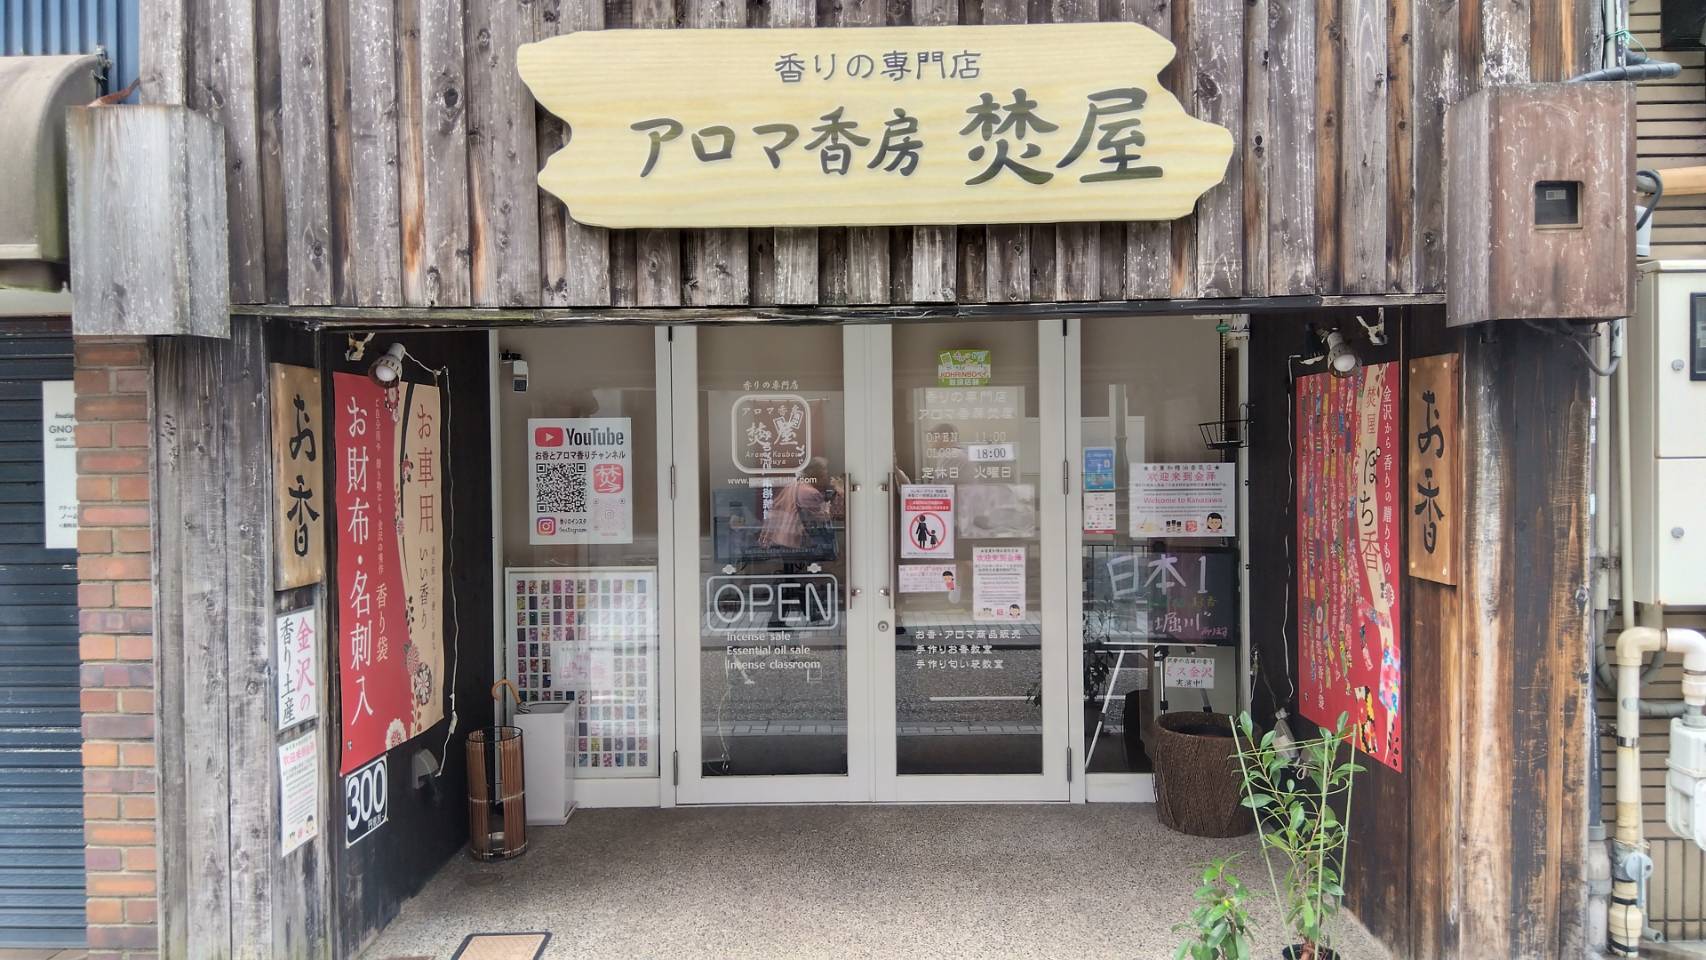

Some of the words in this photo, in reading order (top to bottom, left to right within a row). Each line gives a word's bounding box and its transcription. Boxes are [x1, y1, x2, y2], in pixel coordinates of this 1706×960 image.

[774, 50, 982, 83] 香りの専門店
[630, 106, 925, 178] アロマ香房
[958, 86, 1164, 187] 焚屋
[743, 380, 799, 391] 香りの専門店
[49, 425, 73, 433] GNO
[1383, 385, 1393, 449] 金沢から
[566, 427, 624, 445] YouTube
[926, 432, 958, 442] OPEN
[417, 403, 435, 536] お車用
[535, 450, 626, 460] お香とアロマ香りチャンネル
[745, 450, 770, 458] Arom
[976, 448, 1006, 458] 18:00
[287, 393, 320, 557] お香
[922, 467, 959, 479] 定休日
[974, 466, 1011, 479] 火曜日
[1415, 390, 1446, 554] お香
[1359, 447, 1382, 571] ぽち香
[1382, 455, 1393, 575] 香りの贈りもの
[346, 396, 374, 726] お財布・名刺入
[419, 547, 430, 631] いい香り
[714, 583, 832, 623] OPEN
[376, 582, 388, 663] 香り袋
[727, 631, 765, 641] Incense
[770, 631, 791, 641] sale
[915, 630, 1021, 640] お香・アロマ商品販売
[297, 617, 315, 712] 金沢の
[727, 645, 771, 655] Essential
[774, 645, 787, 655] oil
[790, 645, 811, 655] sale
[727, 659, 766, 669] Incense
[769, 659, 821, 669] classroom
[916, 645, 993, 654] 手作りお香教室
[916, 659, 1004, 669] 手作り匂い袋教室
[280, 617, 296, 725] 香り土産
[347, 762, 386, 830] 300
